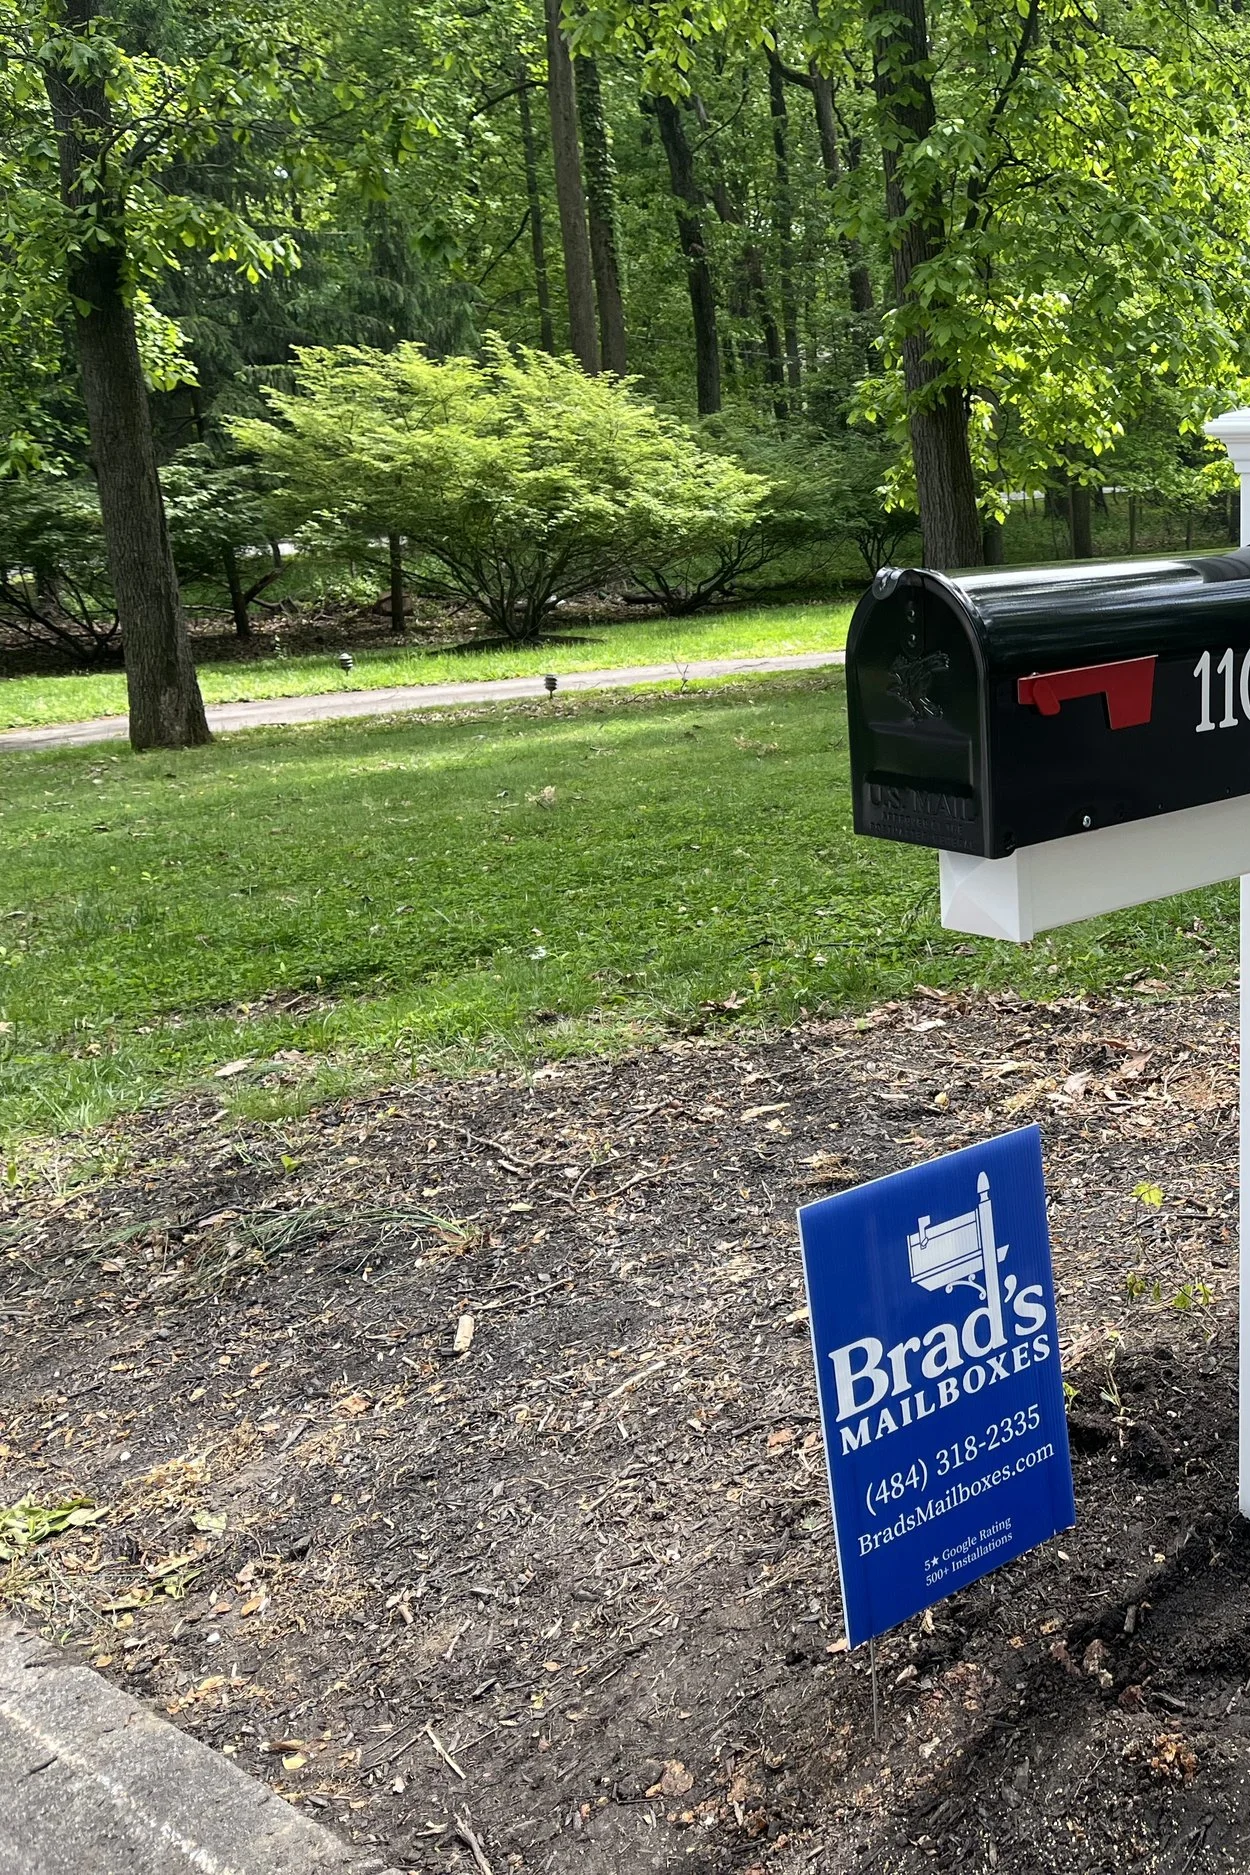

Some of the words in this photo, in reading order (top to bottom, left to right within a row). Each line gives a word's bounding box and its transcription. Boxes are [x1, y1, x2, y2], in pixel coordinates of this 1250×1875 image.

[868, 783, 906, 811] U.S.
[911, 788, 977, 824] MAIL
[828, 1274, 1047, 1423] Brad's
[840, 1334, 1051, 1456] MAILBOXES
[857, 1442, 1055, 1557] BradsMailboxes.com
[866, 1458, 928, 1516] (484)
[935, 1403, 1041, 1476] 318-2335
[925, 1566, 950, 1587] 500+
[951, 1532, 1013, 1573] Installations
[942, 1536, 977, 1561] Google
[979, 1517, 1012, 1542] Rating
